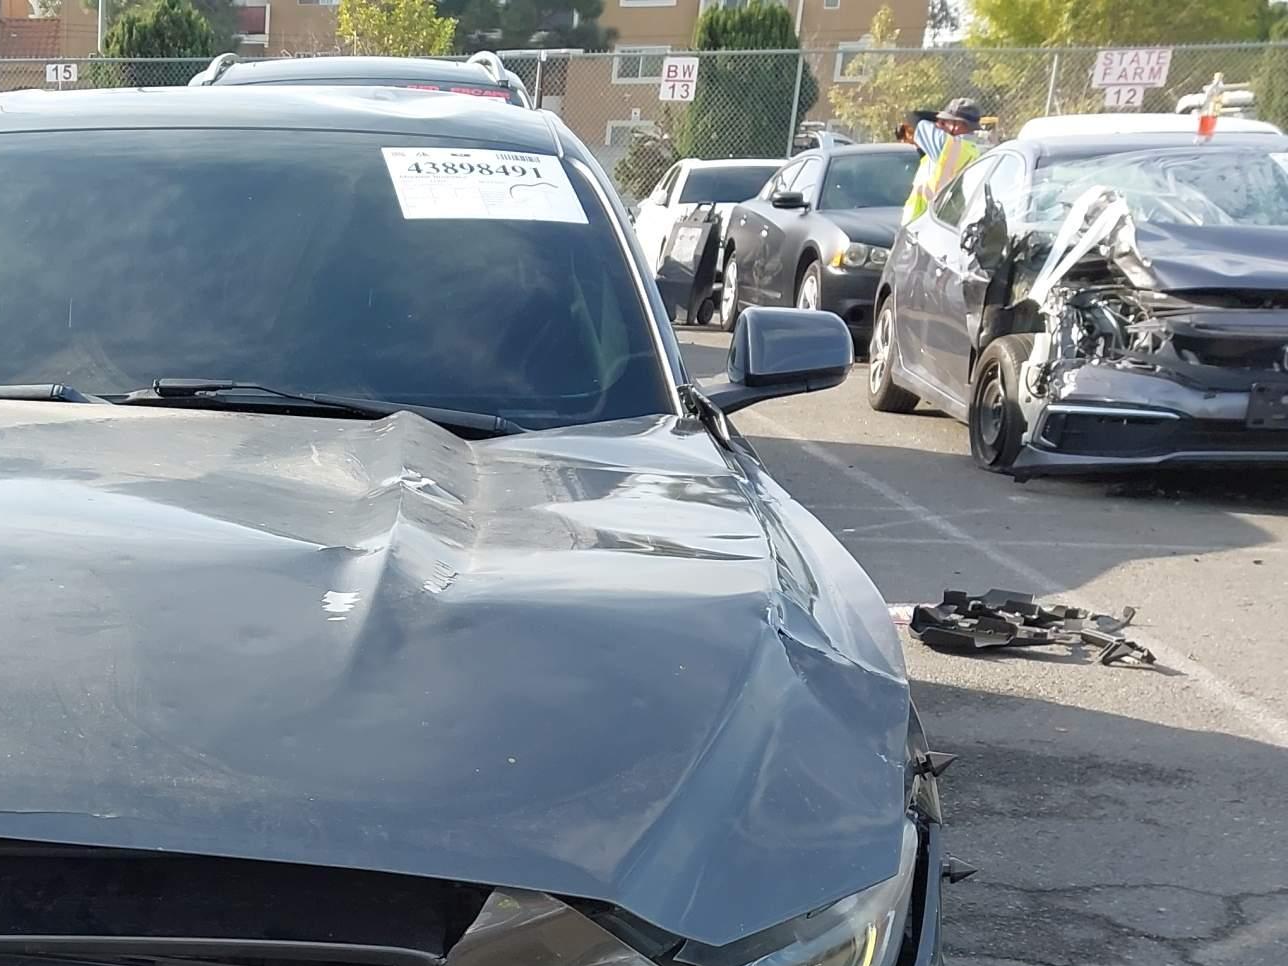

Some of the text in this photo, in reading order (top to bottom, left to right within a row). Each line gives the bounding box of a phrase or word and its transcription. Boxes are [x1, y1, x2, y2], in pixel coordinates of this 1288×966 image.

[1103, 50, 1168, 66] STATE
[52, 64, 72, 80] 15
[667, 64, 694, 78] BW
[1102, 66, 1163, 81] FARM
[668, 83, 690, 99] 13
[1113, 88, 1137, 104] 12
[407, 161, 543, 179] 43898491
